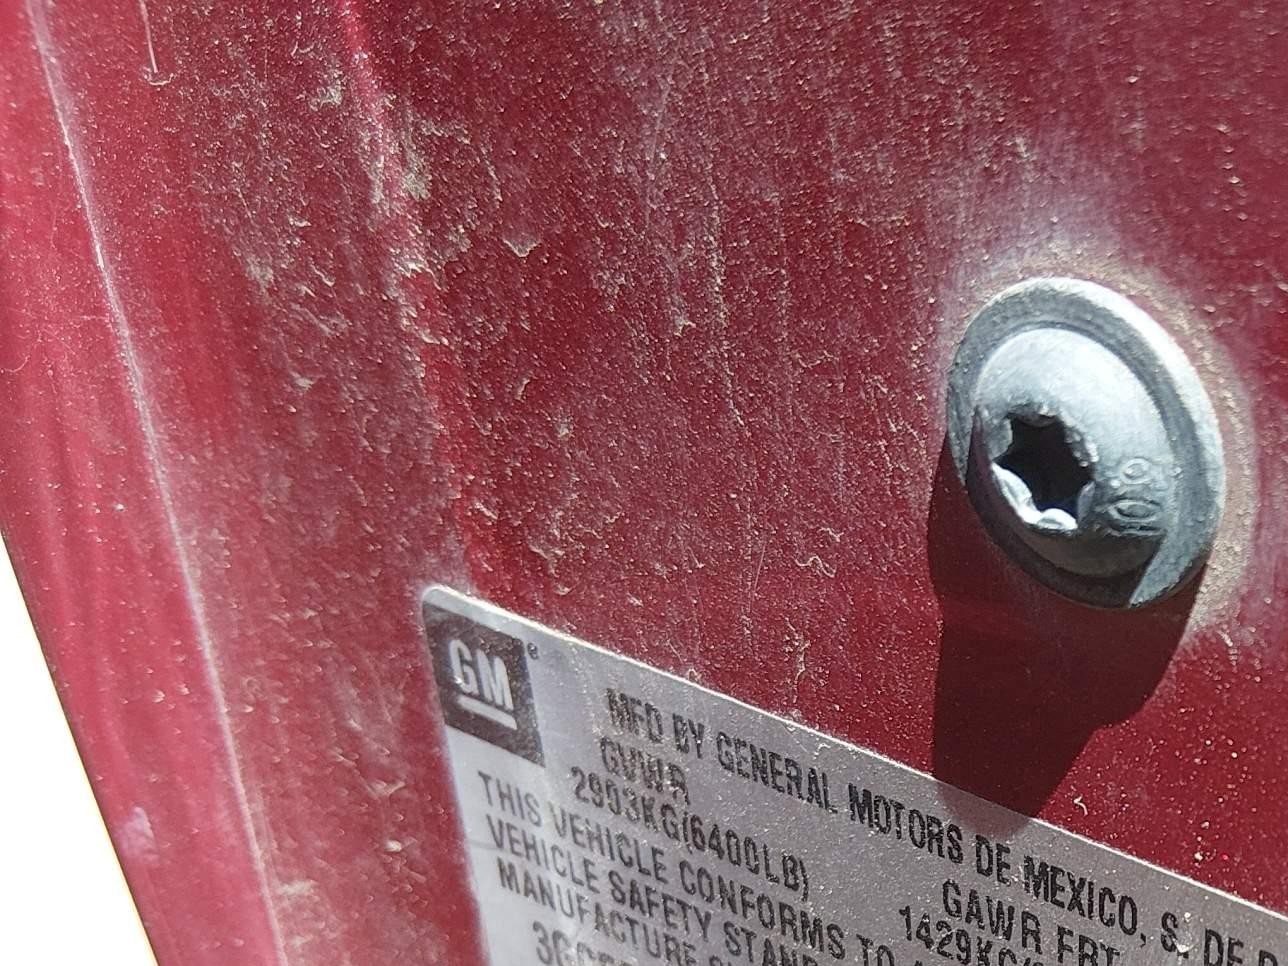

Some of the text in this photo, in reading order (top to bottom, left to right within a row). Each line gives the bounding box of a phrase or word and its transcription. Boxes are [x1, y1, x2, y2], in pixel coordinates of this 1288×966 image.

[450, 640, 514, 711] GM
[600, 736, 690, 804] GVWR
[607, 688, 663, 743] MFD
[673, 713, 704, 759] BY
[716, 731, 837, 814] GENERAL
[848, 783, 963, 863] MOTORS
[975, 833, 1011, 884] DE
[1023, 855, 1147, 948] MEXICO,
[478, 770, 541, 828] THIS
[554, 793, 668, 884] VEHICLE
[680, 859, 845, 960] CONFORMS
[487, 817, 600, 907] VEHICLE
[611, 871, 712, 941] SAFETY
[942, 879, 1042, 963] GAWR
